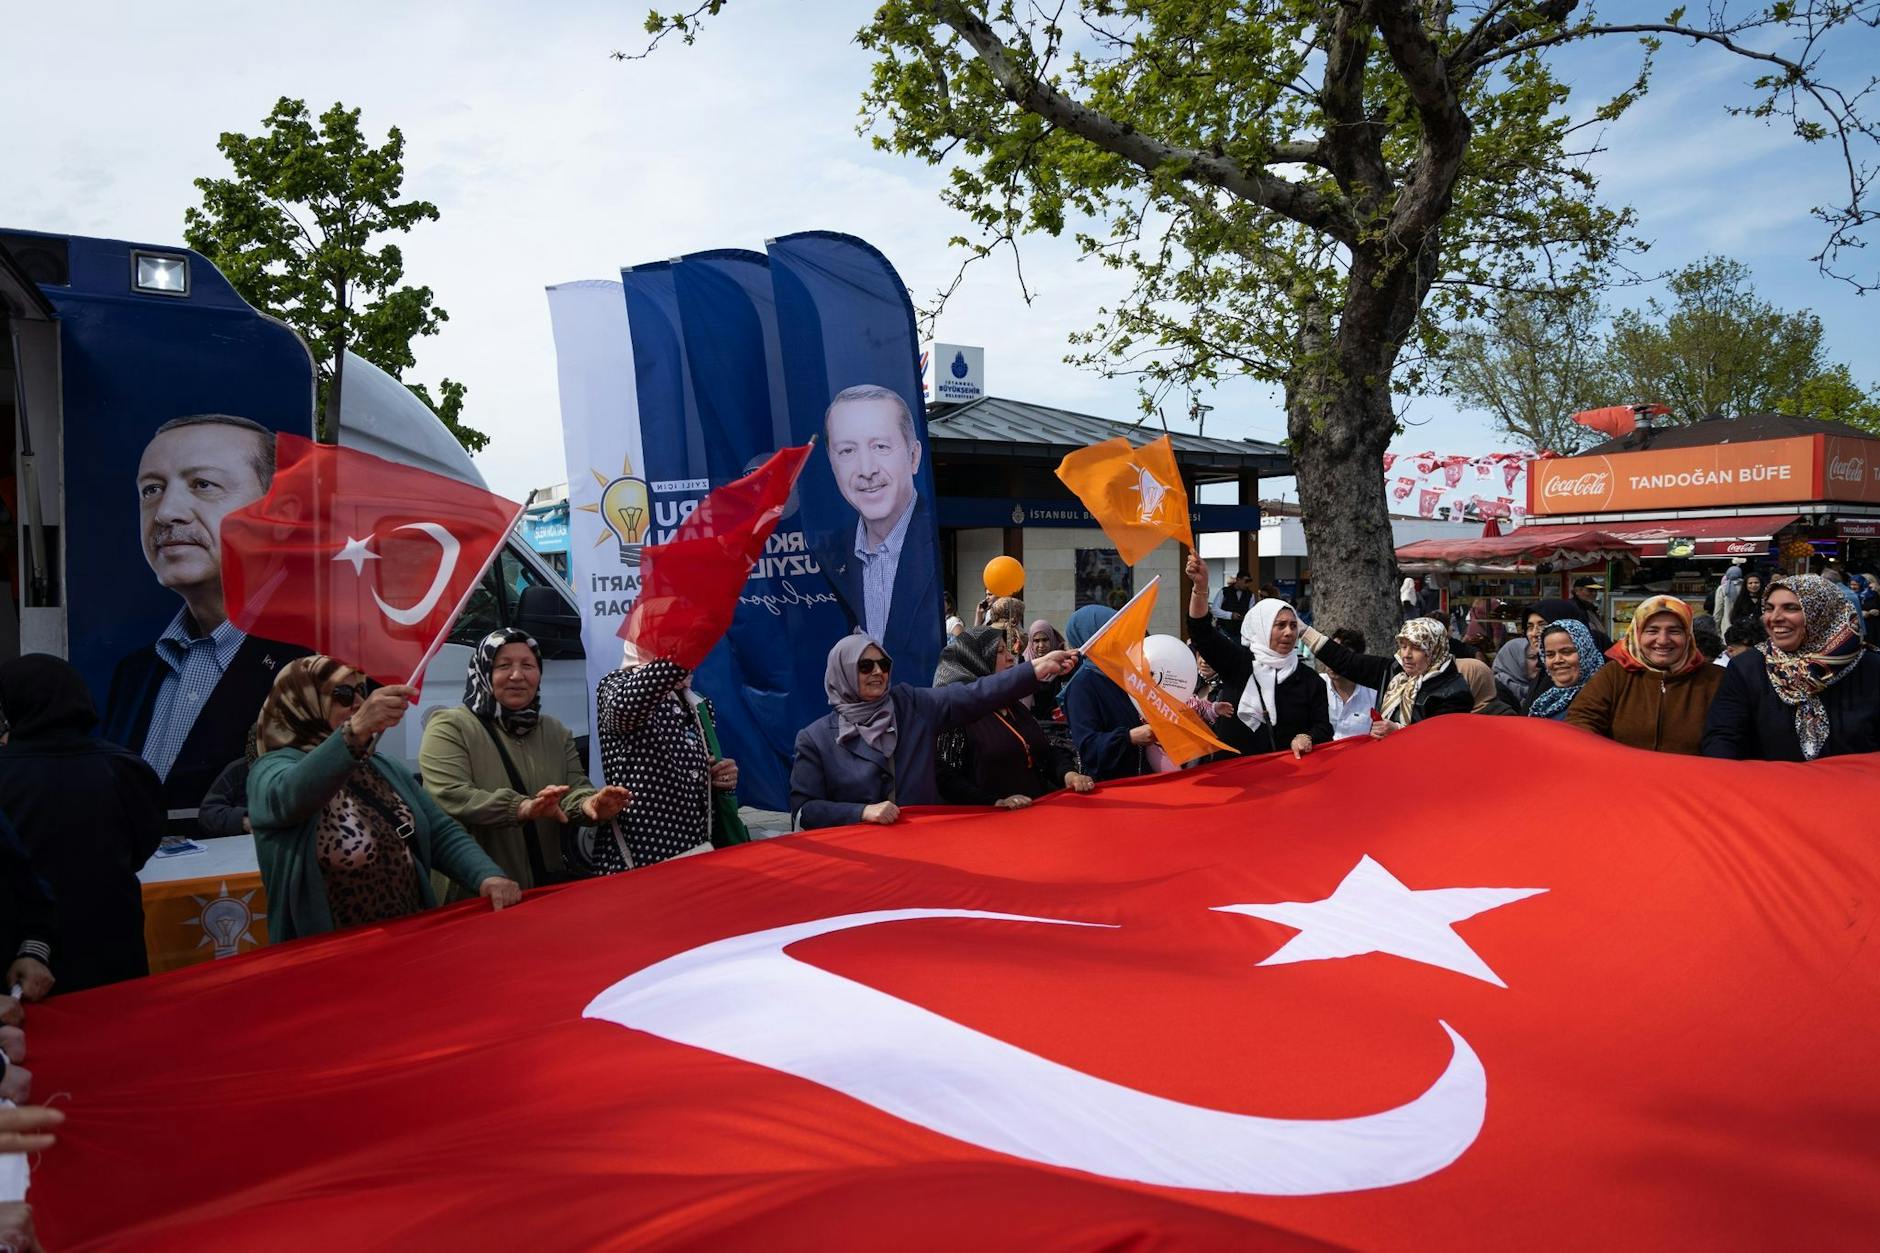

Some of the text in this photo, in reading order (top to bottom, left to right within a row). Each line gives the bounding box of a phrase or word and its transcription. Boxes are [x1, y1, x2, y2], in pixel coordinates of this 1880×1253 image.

[1544, 471, 1609, 498] Coca-Cola
[1629, 464, 1792, 490] TANDOĞAN BÜFE
[1029, 507, 1080, 520] İSTANBUL
[1726, 542, 1757, 553] Coca-Cola
[1128, 672, 1147, 693] AK
